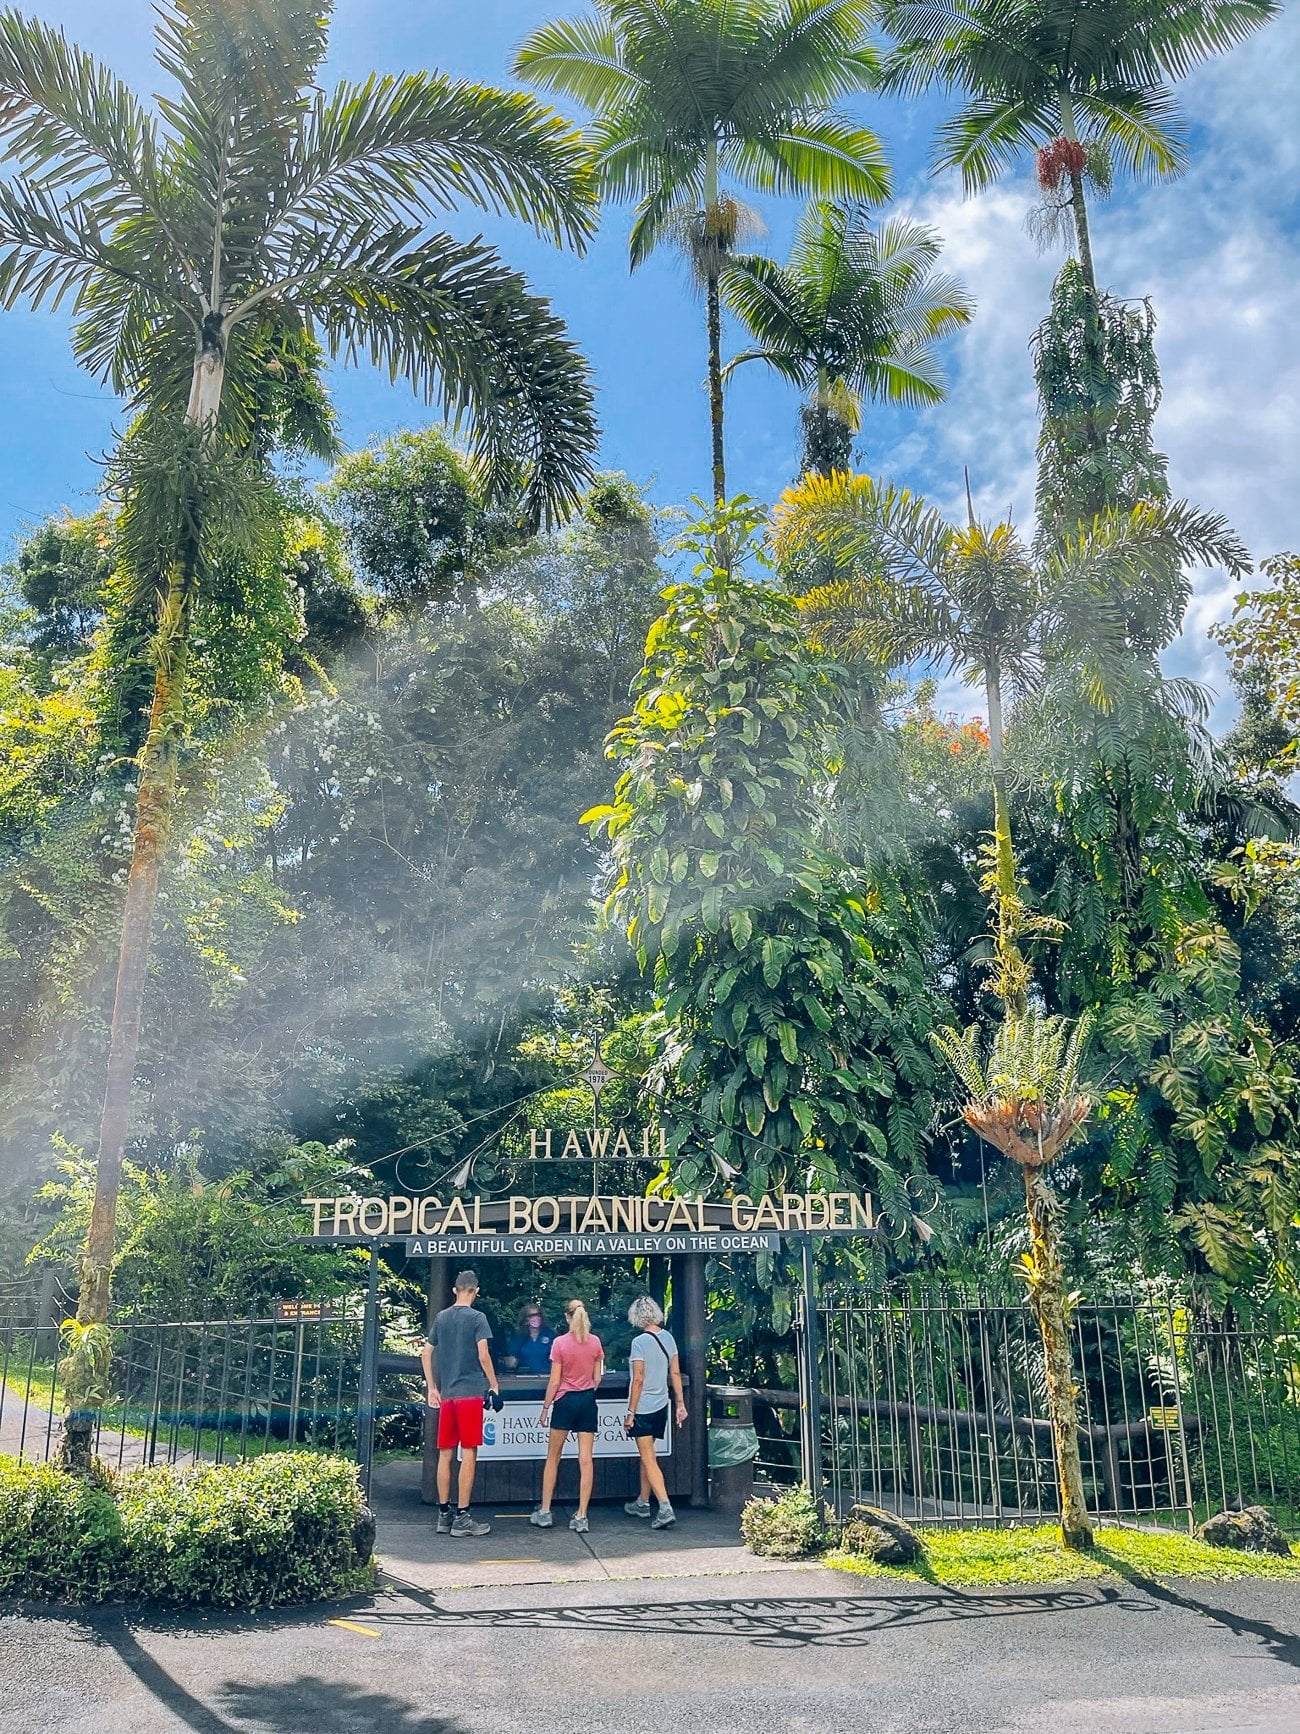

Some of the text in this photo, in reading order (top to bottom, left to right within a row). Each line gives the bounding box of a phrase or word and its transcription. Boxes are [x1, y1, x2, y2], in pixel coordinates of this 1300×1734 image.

[589, 1075, 606, 1084] 1978
[529, 1127, 667, 1160] HAWAII
[301, 1192, 874, 1236] TROPICAL BOTANICAL GARDEN
[412, 1236, 769, 1254] A BEAUTIFUL GARDEN IN A VALLEY ON THE OCEAN
